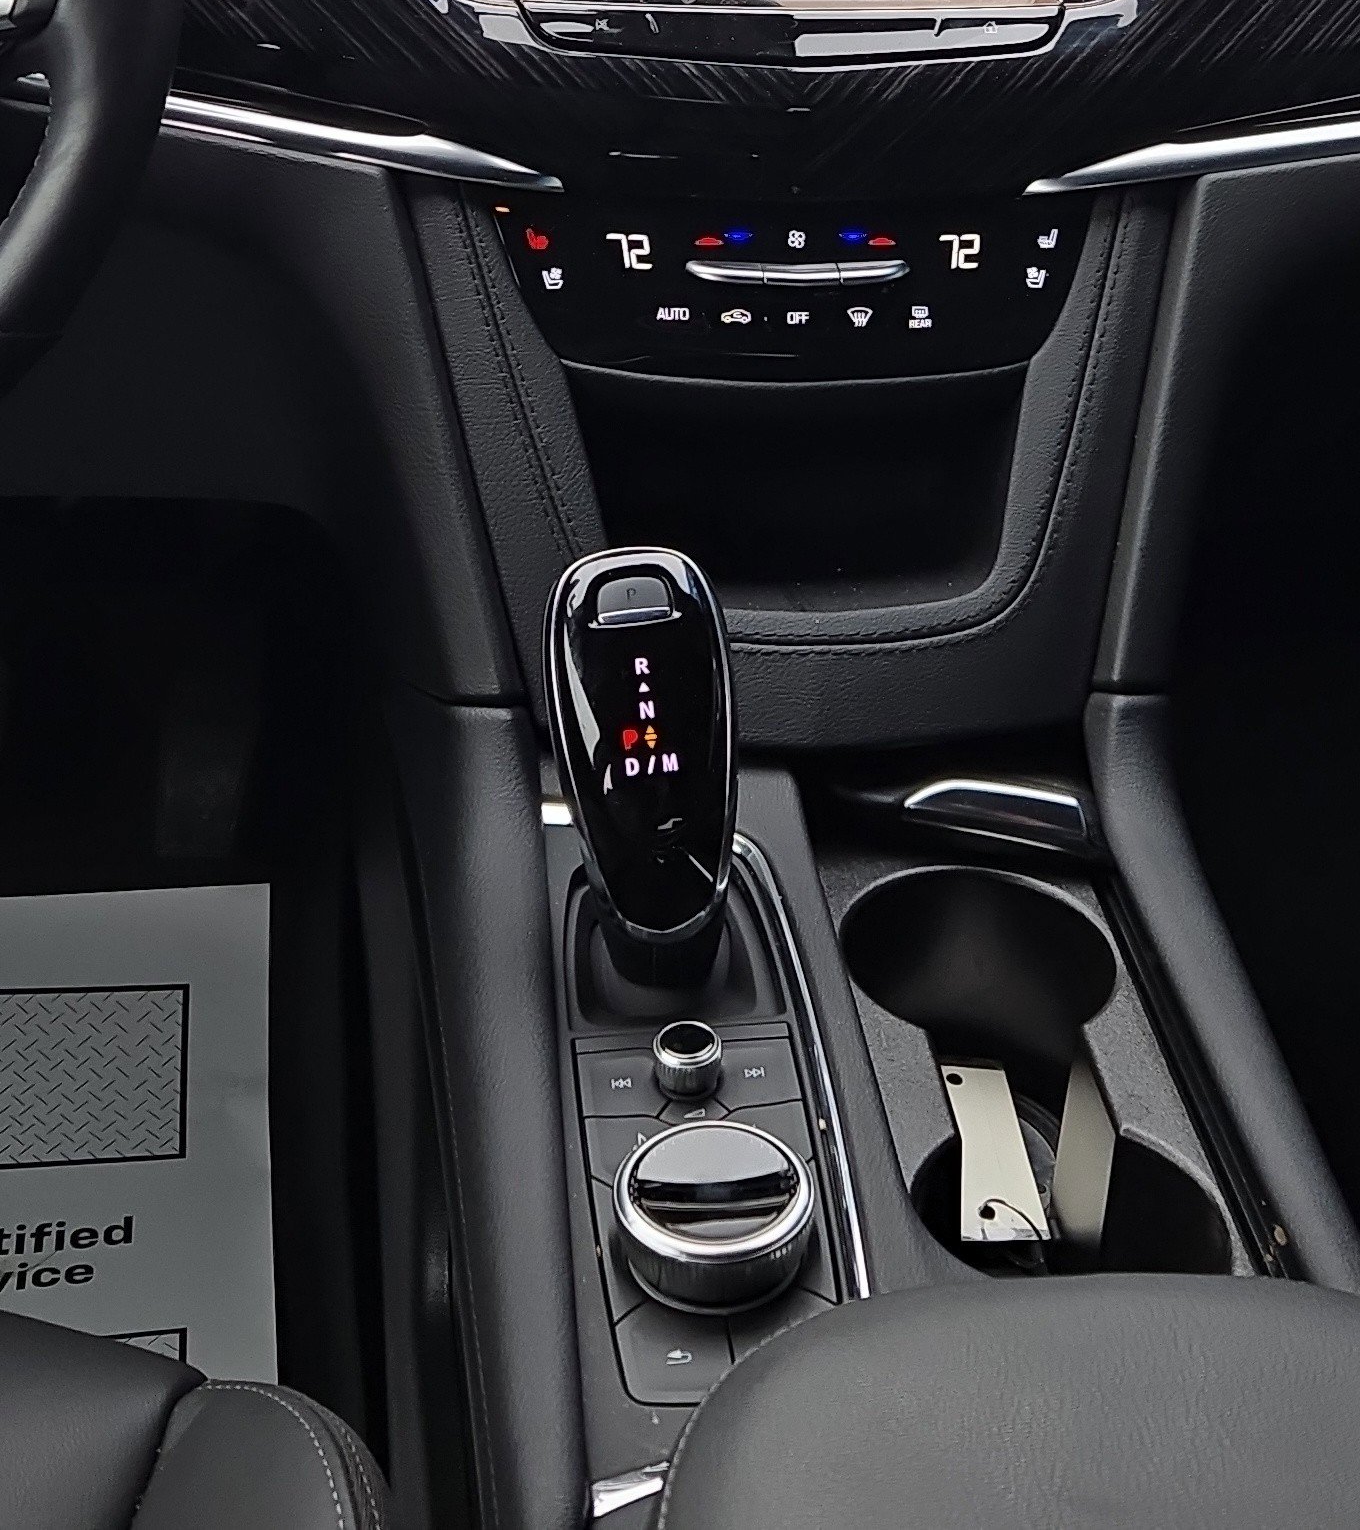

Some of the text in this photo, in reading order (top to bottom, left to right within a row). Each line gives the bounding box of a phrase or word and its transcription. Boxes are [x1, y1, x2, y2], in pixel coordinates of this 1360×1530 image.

[605, 233, 653, 270] 72
[939, 233, 981, 270] 72
[656, 307, 690, 321] AUTO
[786, 311, 810, 325] OFF
[908, 318, 933, 329] REAR
[634, 657, 650, 675] R
[639, 701, 655, 720] N
[622, 728, 639, 751] P
